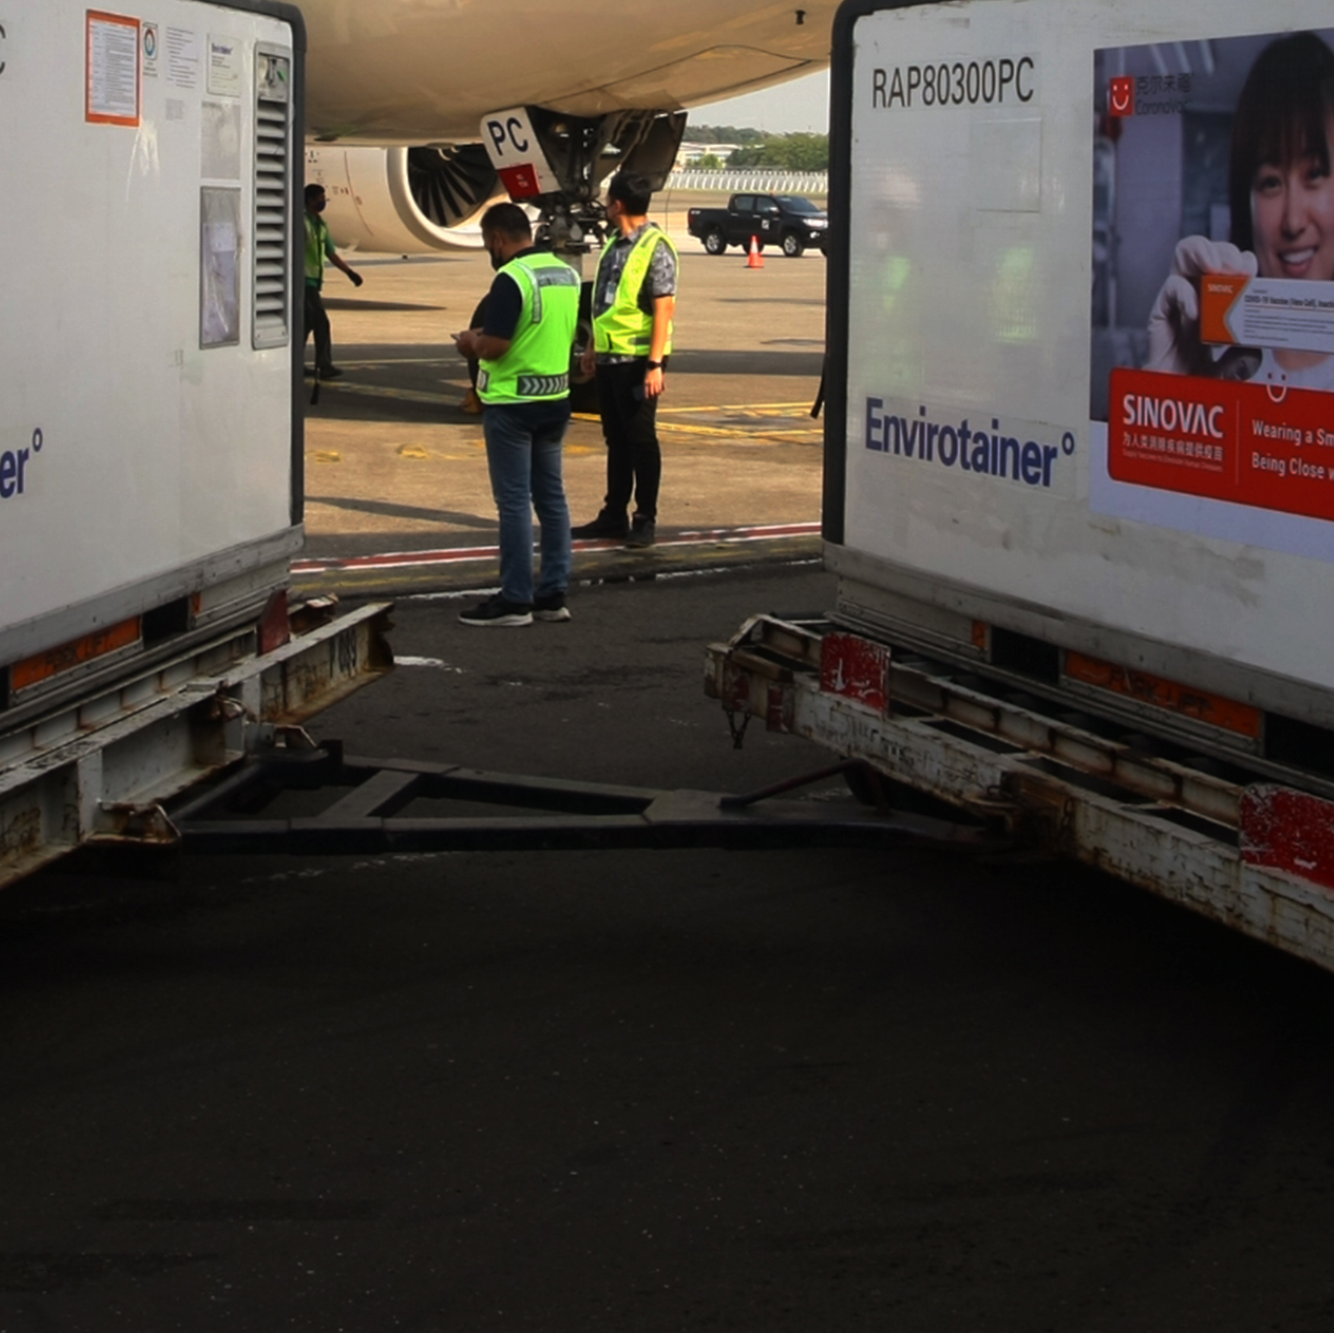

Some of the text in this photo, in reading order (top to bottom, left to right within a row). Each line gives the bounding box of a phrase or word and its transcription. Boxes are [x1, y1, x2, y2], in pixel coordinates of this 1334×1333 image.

[872, 56, 1035, 109] RAP80300PC
[487, 117, 529, 156] PC
[1123, 393, 1225, 439] SINOVAC
[1252, 419, 1302, 447] Wearing
[1305, 430, 1314, 444] a
[1252, 451, 1287, 478] Being
[1289, 457, 1325, 480] Close
